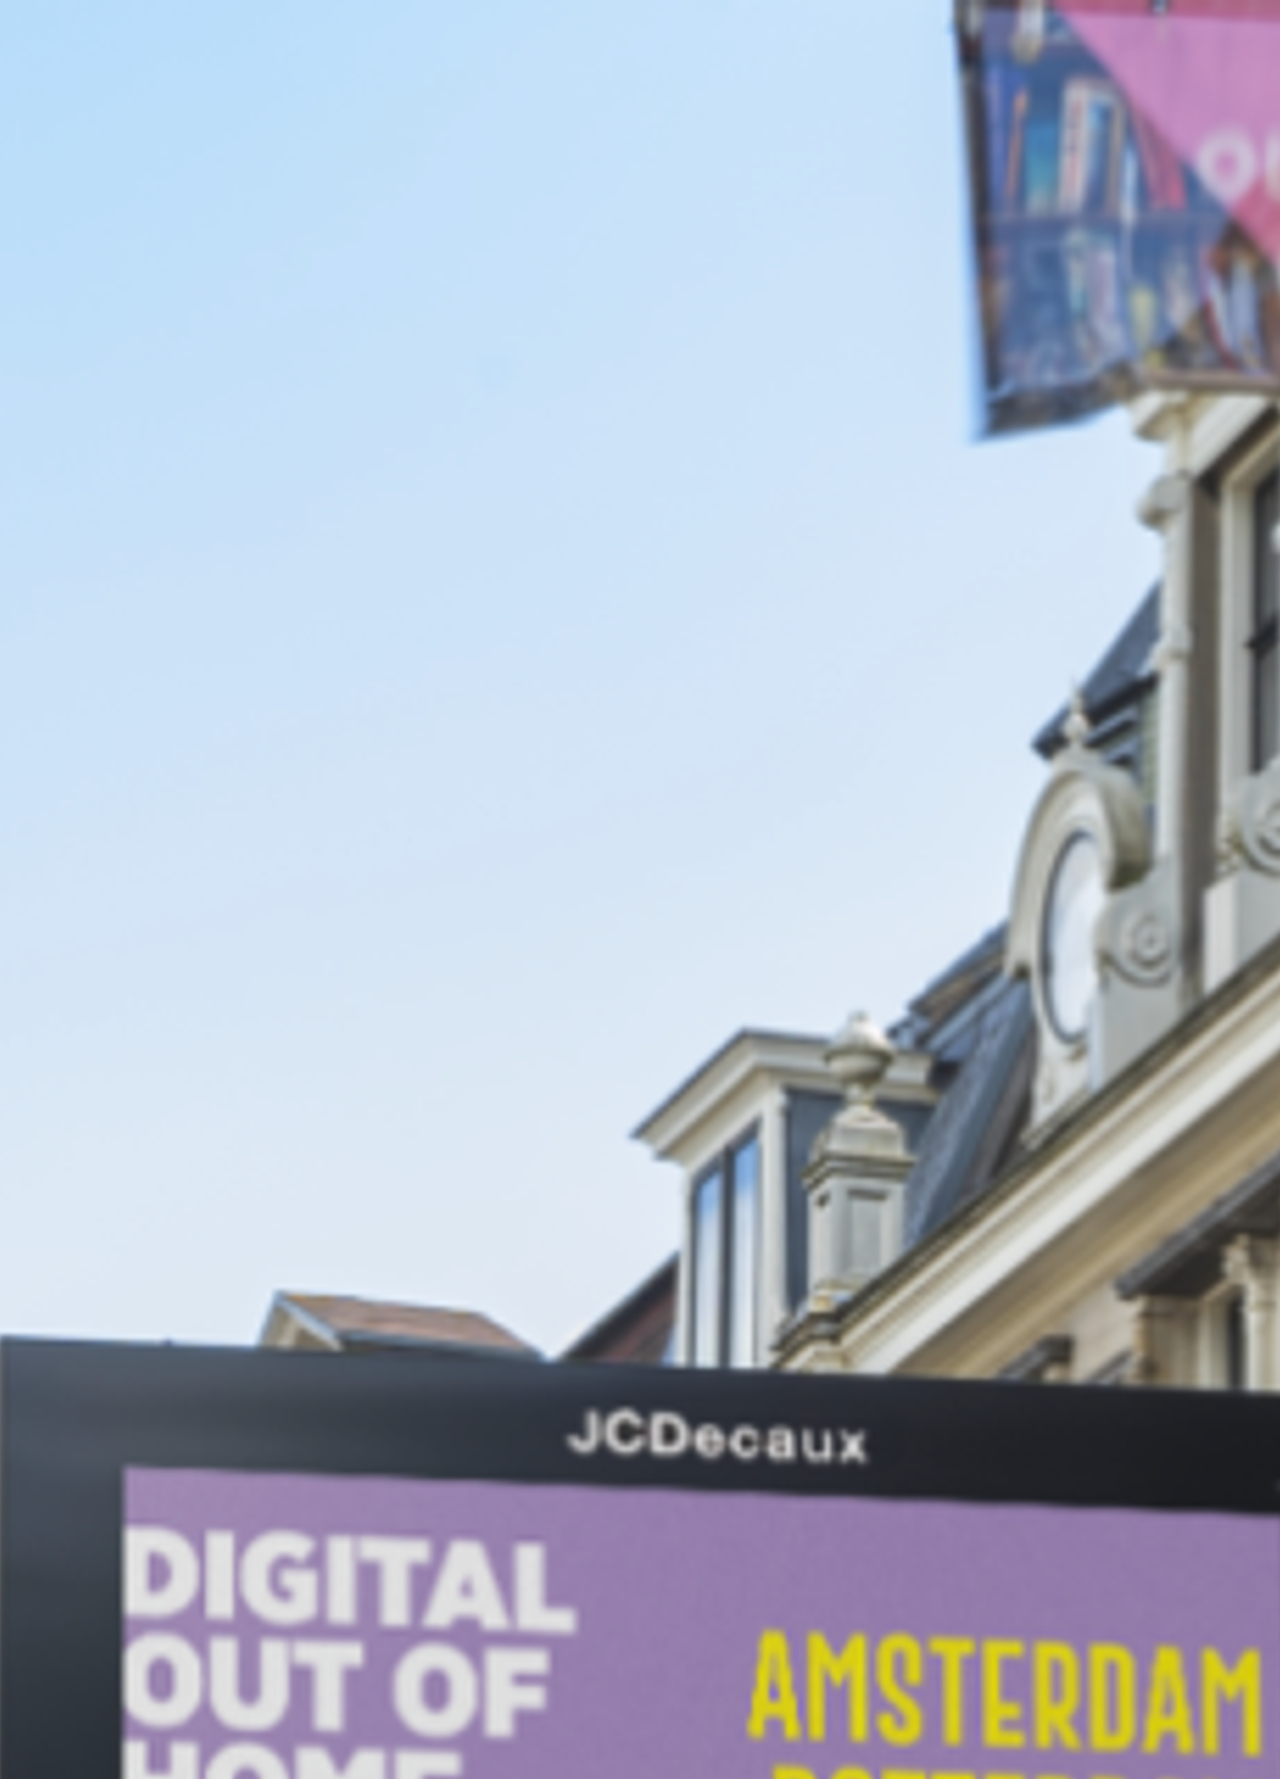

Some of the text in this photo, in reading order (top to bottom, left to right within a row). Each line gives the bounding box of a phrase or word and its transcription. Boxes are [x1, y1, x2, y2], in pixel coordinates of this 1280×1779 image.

[566, 1406, 867, 1464] JCDecaux
[123, 1525, 577, 1635] DIGITAL
[123, 1633, 550, 1738] OUT OF
[746, 1629, 1263, 1758] AMSTERDAM
